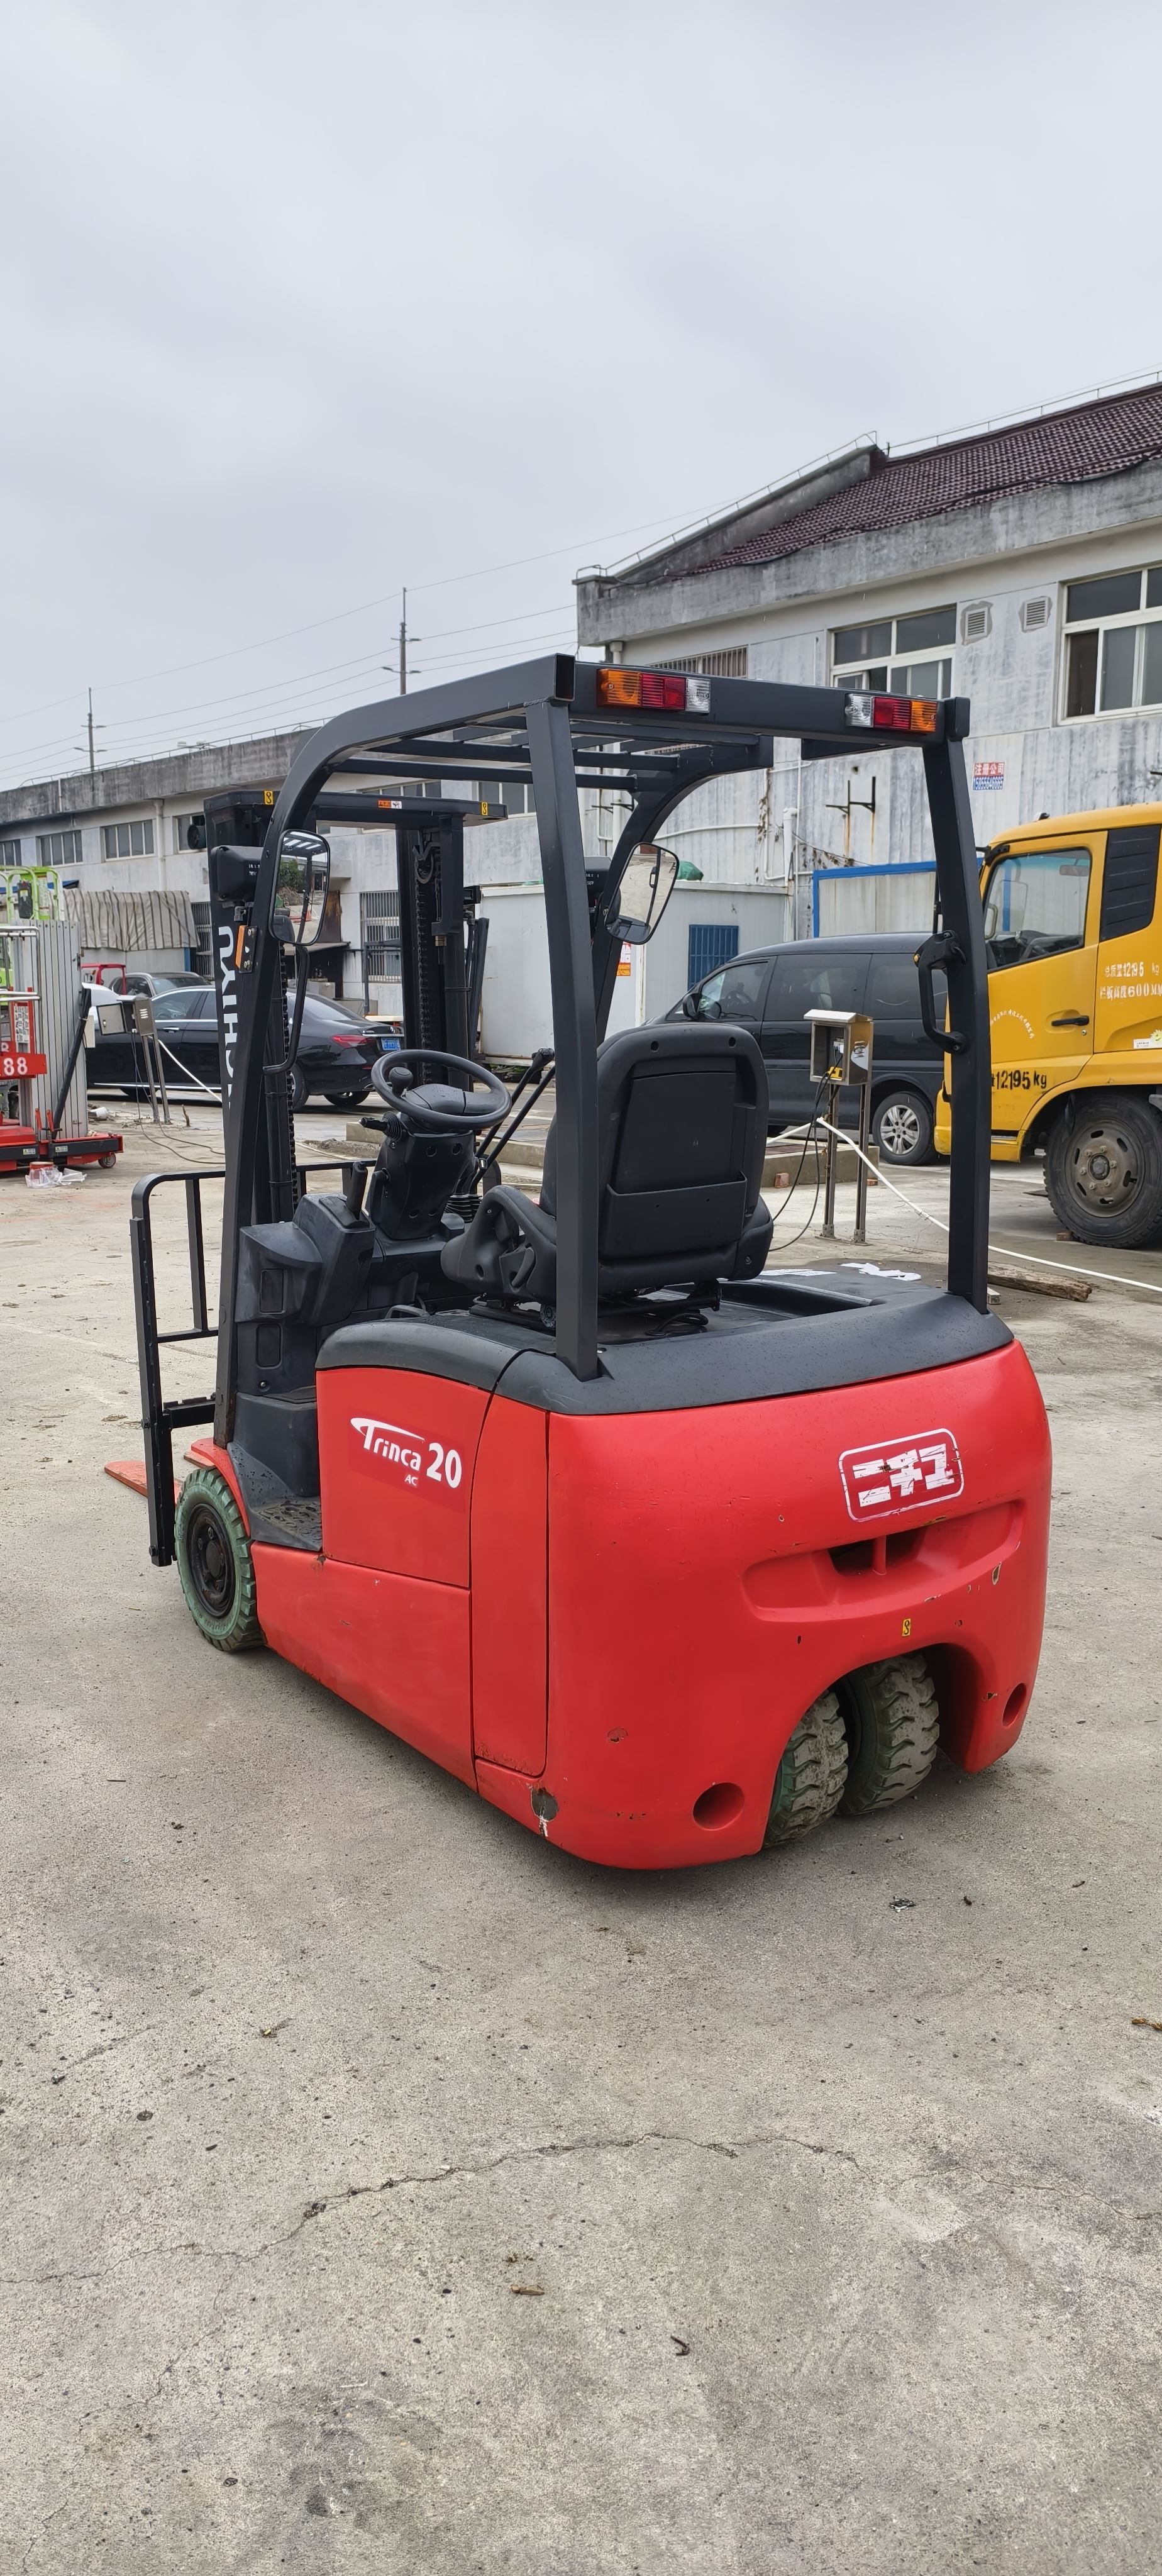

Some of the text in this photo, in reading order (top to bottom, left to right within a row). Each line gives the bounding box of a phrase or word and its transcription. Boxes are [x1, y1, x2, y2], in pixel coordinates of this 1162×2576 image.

[975, 763, 1004, 775] 注册公司
[0, 1057, 28, 1076] 88
[1033, 1070, 1047, 1089] kg
[350, 1418, 462, 1489] Trinca 20
[405, 1474, 418, 1487] AC
